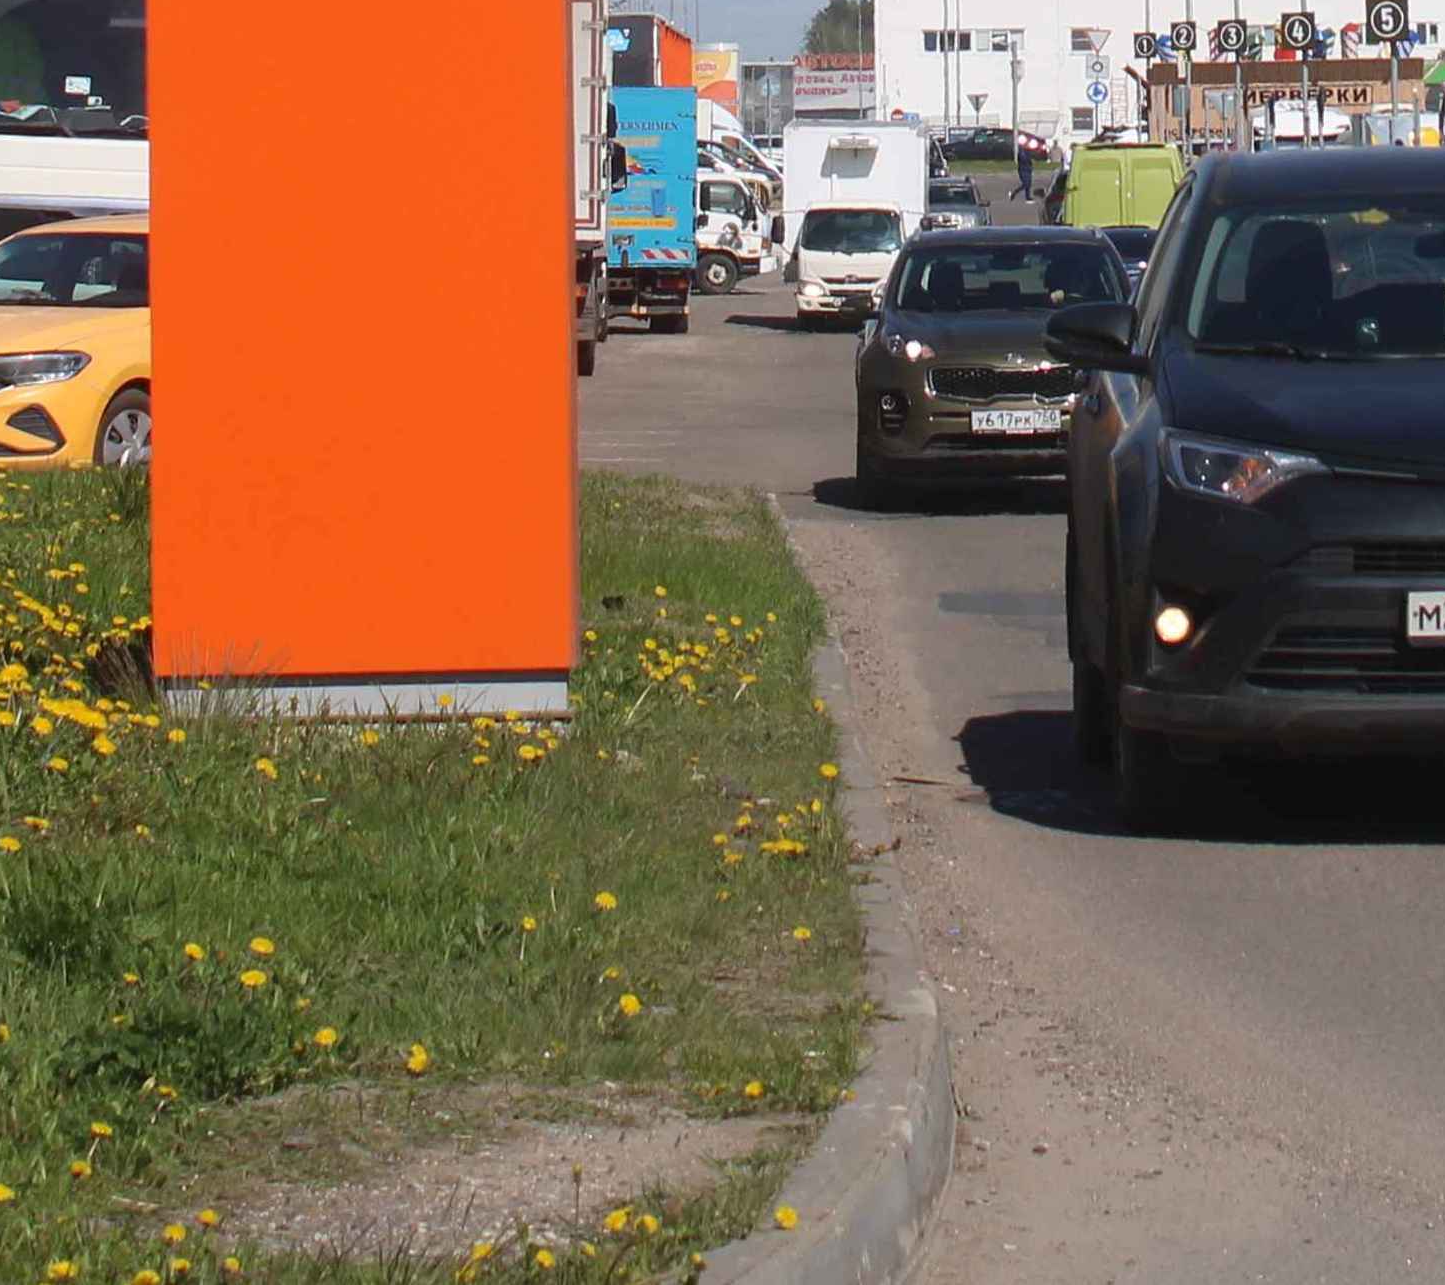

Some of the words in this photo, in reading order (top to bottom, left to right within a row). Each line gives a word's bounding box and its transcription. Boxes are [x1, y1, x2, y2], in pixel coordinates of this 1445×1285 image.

[1381, 7, 1394, 29] 5
[1179, 27, 1188, 44] 2
[1227, 27, 1237, 44] 3
[1292, 23, 1304, 40] 4
[1141, 37, 1148, 52] 1
